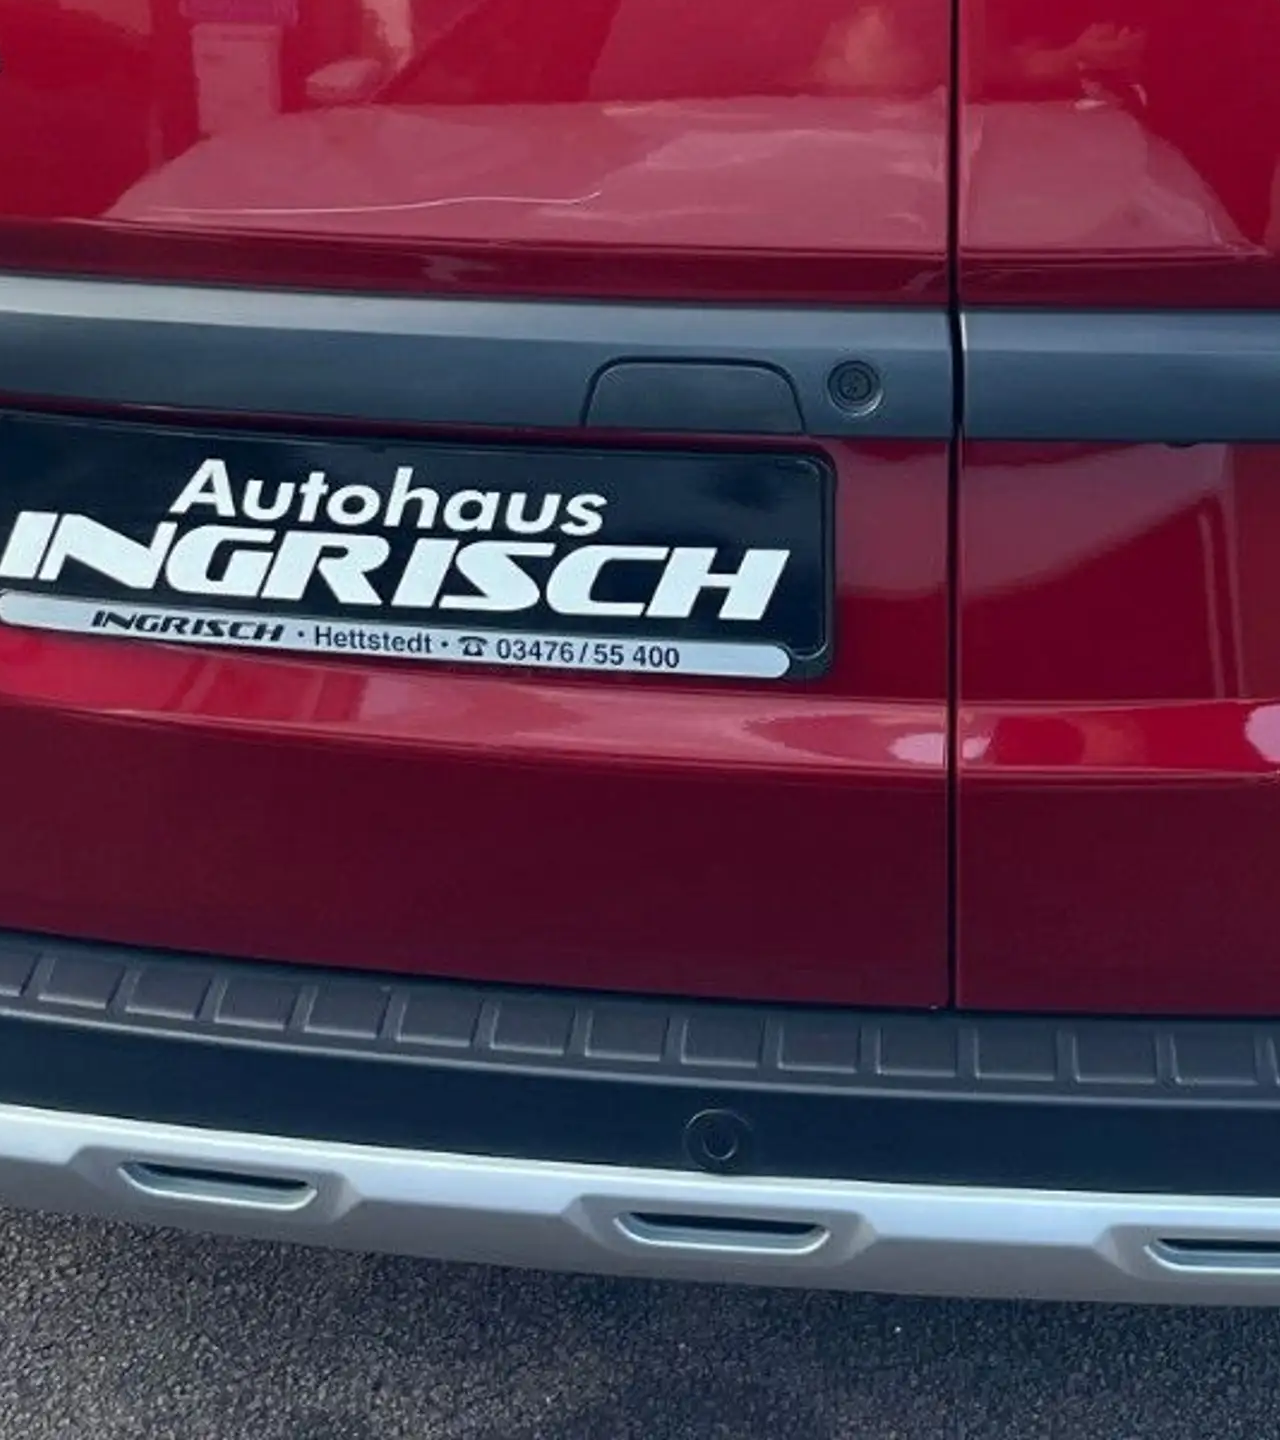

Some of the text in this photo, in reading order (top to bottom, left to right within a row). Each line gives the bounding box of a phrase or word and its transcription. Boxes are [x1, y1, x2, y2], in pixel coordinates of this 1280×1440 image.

[169, 458, 608, 537] Autohaus
[91, 609, 285, 642] INGRISCH
[314, 624, 433, 655] Hettstedt
[632, 645, 681, 670] 400
